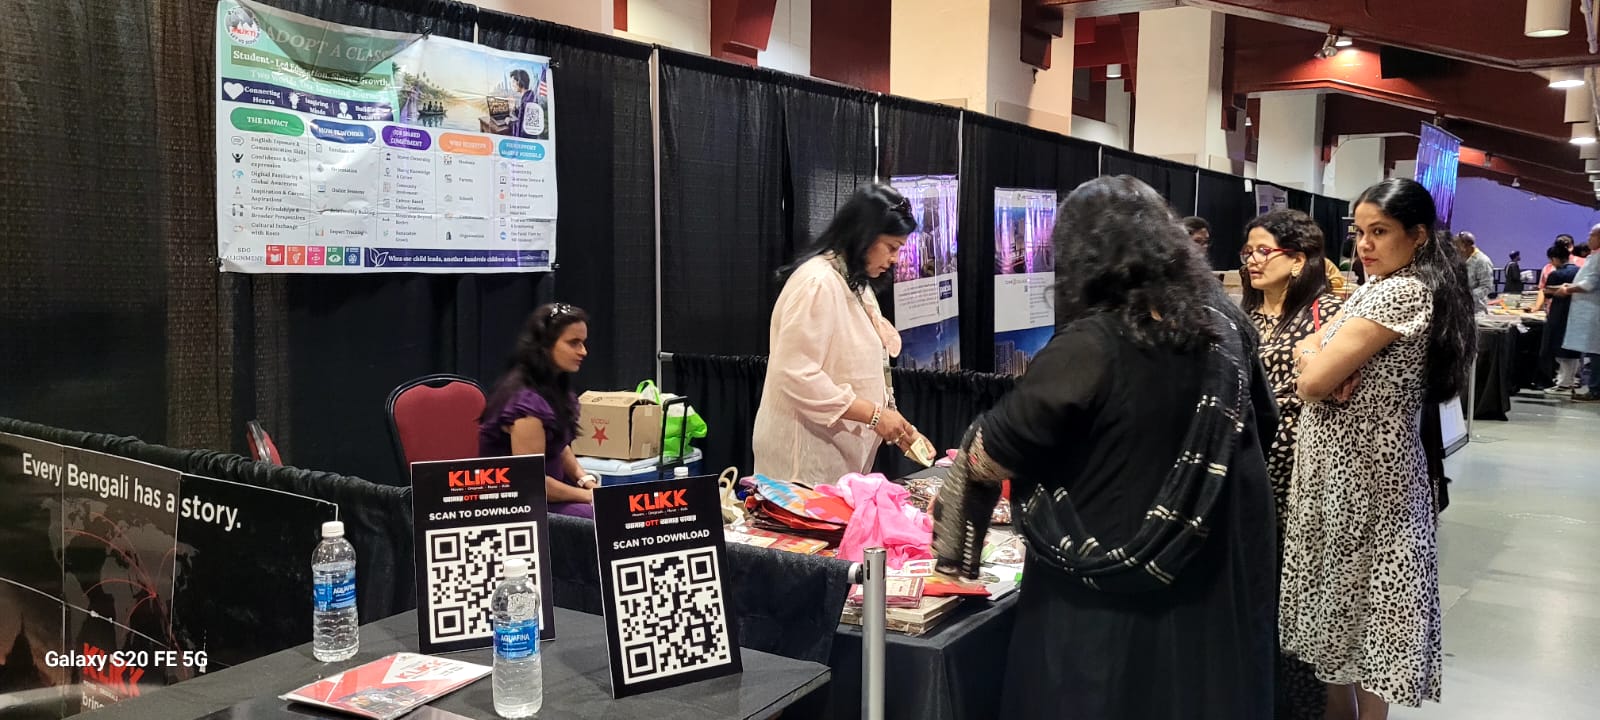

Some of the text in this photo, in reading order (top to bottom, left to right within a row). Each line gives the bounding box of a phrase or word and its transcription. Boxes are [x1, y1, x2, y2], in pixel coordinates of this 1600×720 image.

[267, 26, 328, 53] ADOPT
[331, 46, 341, 57] A
[244, 86, 281, 99] Connecting
[252, 96, 275, 105] Hearts
[247, 116, 289, 128] THE IMPACT
[22, 453, 242, 532] Every Bengali has a story.
[463, 494, 479, 502] OTT
[429, 505, 532, 521] SCAN TO DOWNLOAD
[645, 519, 659, 527] OTT
[613, 529, 710, 550] SCAN TO DOWNLOAD
[332, 584, 356, 596] AQUAFIN
[500, 633, 530, 643] AQUAFINA
[82, 692, 104, 710] brin
